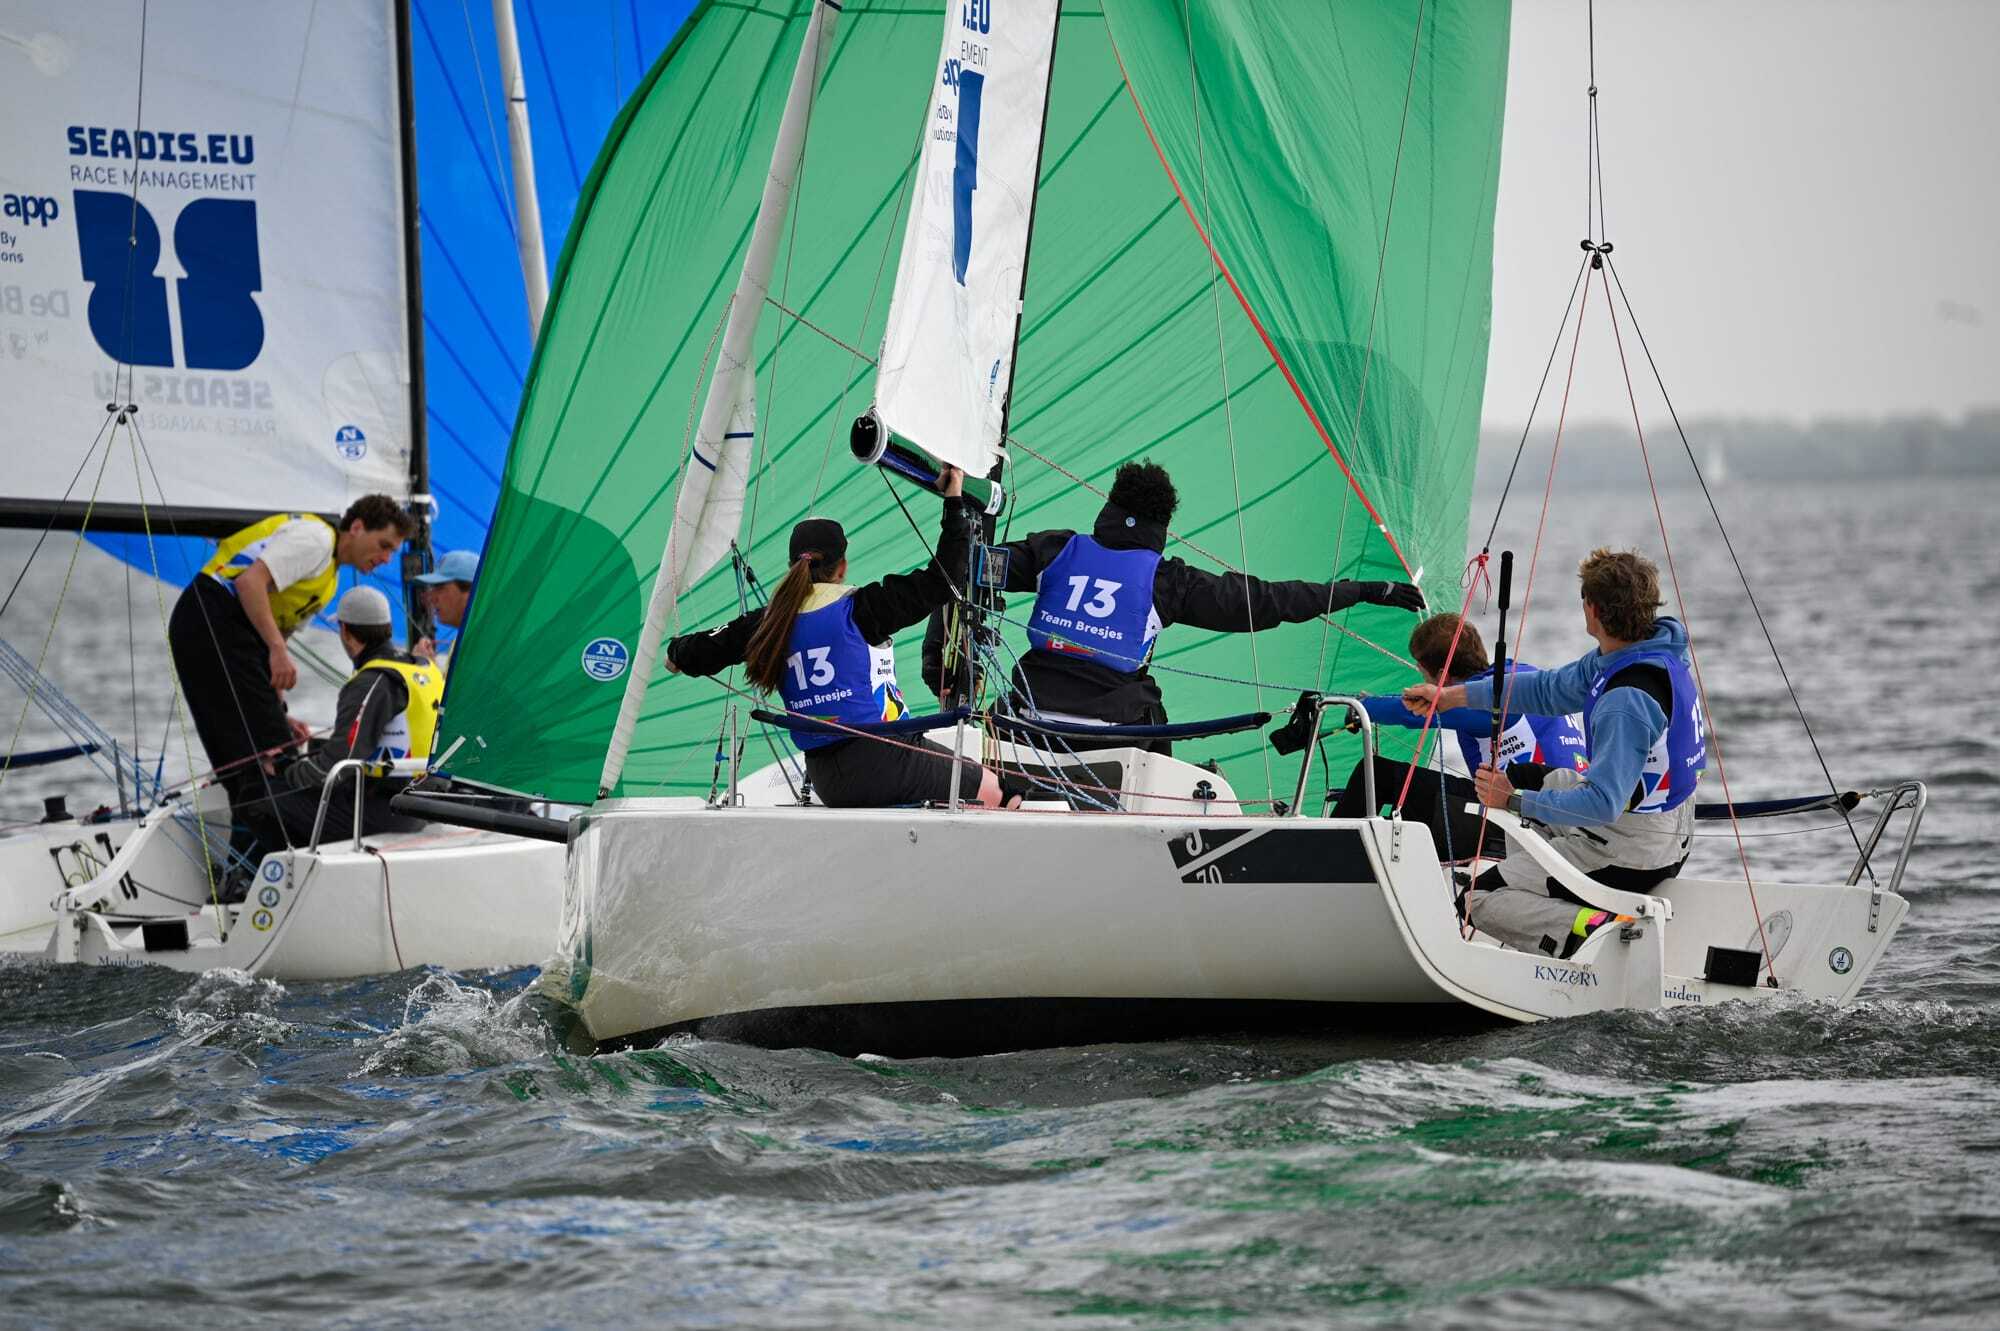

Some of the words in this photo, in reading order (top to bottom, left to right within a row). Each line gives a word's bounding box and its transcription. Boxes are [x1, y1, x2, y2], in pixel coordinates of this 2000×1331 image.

[67, 126, 255, 165] SEADIS.EU
[70, 164, 117, 185] RACE
[123, 168, 257, 191] MANAGEMENT
[3, 193, 59, 227] app
[1065, 575, 1122, 618] 13
[1040, 610, 1072, 628] Team
[1075, 620, 1123, 640] Bresjes
[596, 643, 619, 656] N
[593, 662, 613, 674] S
[787, 646, 835, 691] 13
[790, 698, 813, 710] Team
[814, 688, 853, 705] Bresjes
[1498, 741, 1526, 757] resjes
[1664, 985, 1701, 1003] uiden
